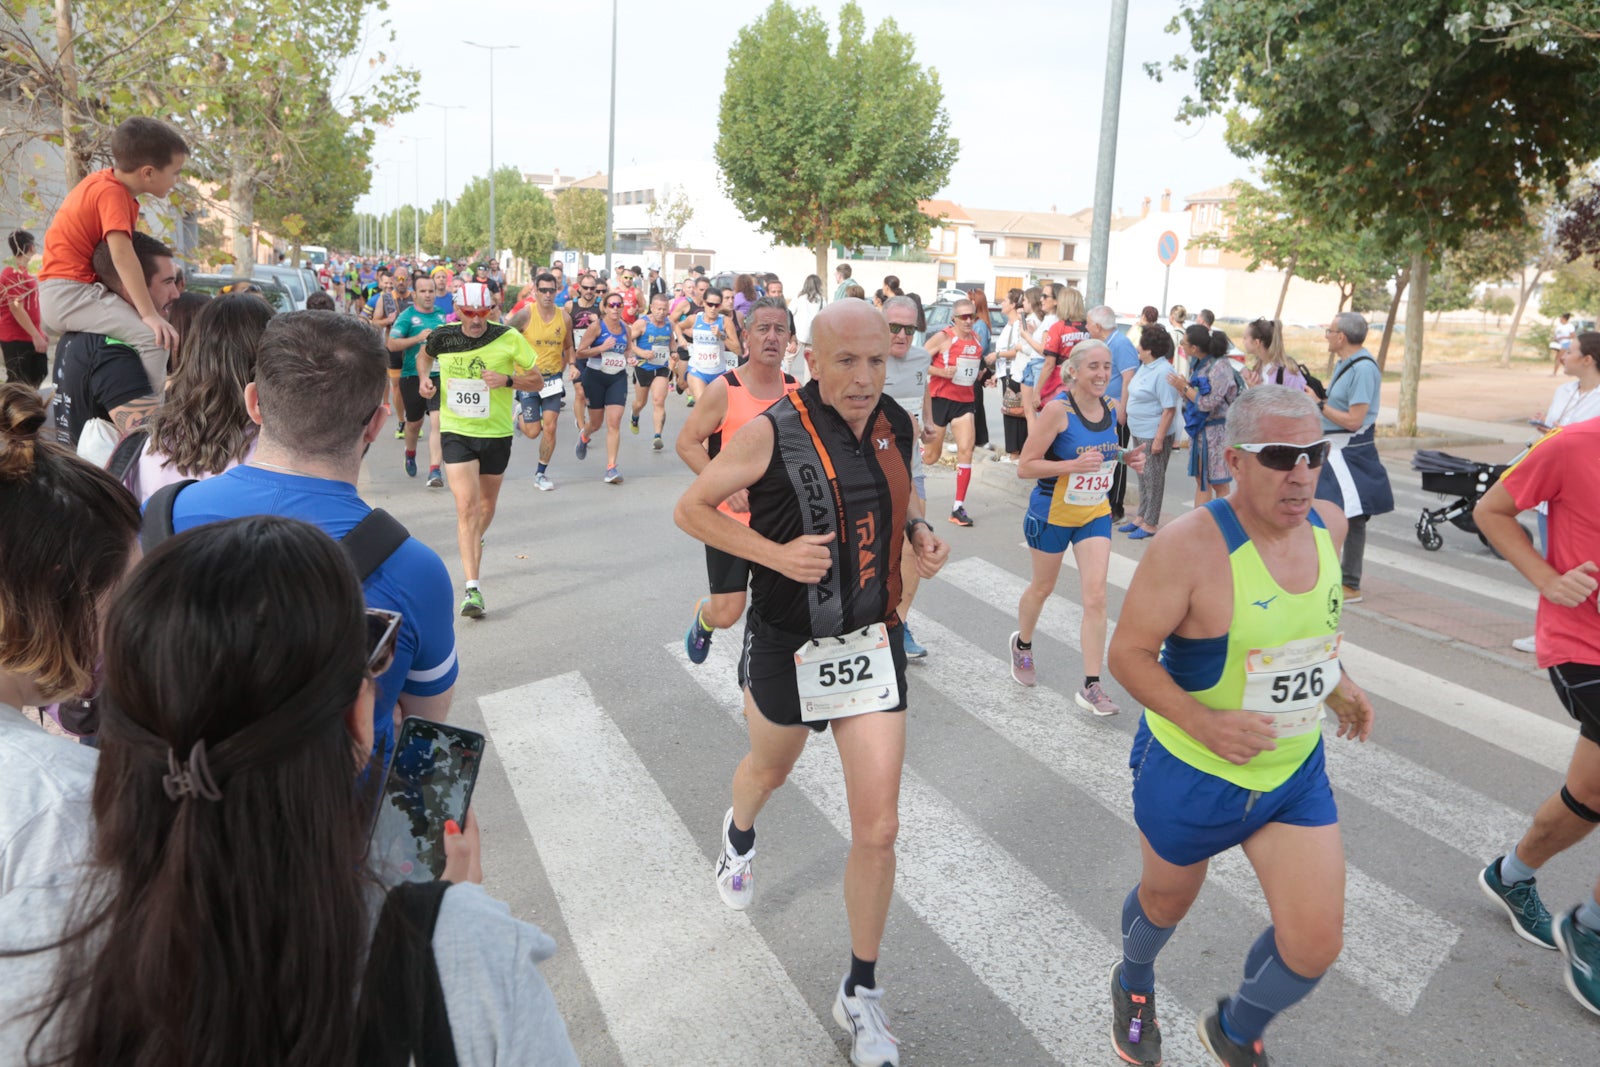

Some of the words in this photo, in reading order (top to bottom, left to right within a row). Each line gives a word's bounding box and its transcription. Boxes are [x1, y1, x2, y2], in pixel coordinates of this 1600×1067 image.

[604, 359, 624, 367] 2022
[964, 368, 974, 377] 13
[456, 392, 480, 404] 369
[1074, 475, 1109, 491] 2134
[855, 511, 877, 590] TRAIL
[819, 655, 873, 687] 552
[1271, 667, 1324, 704] 526
